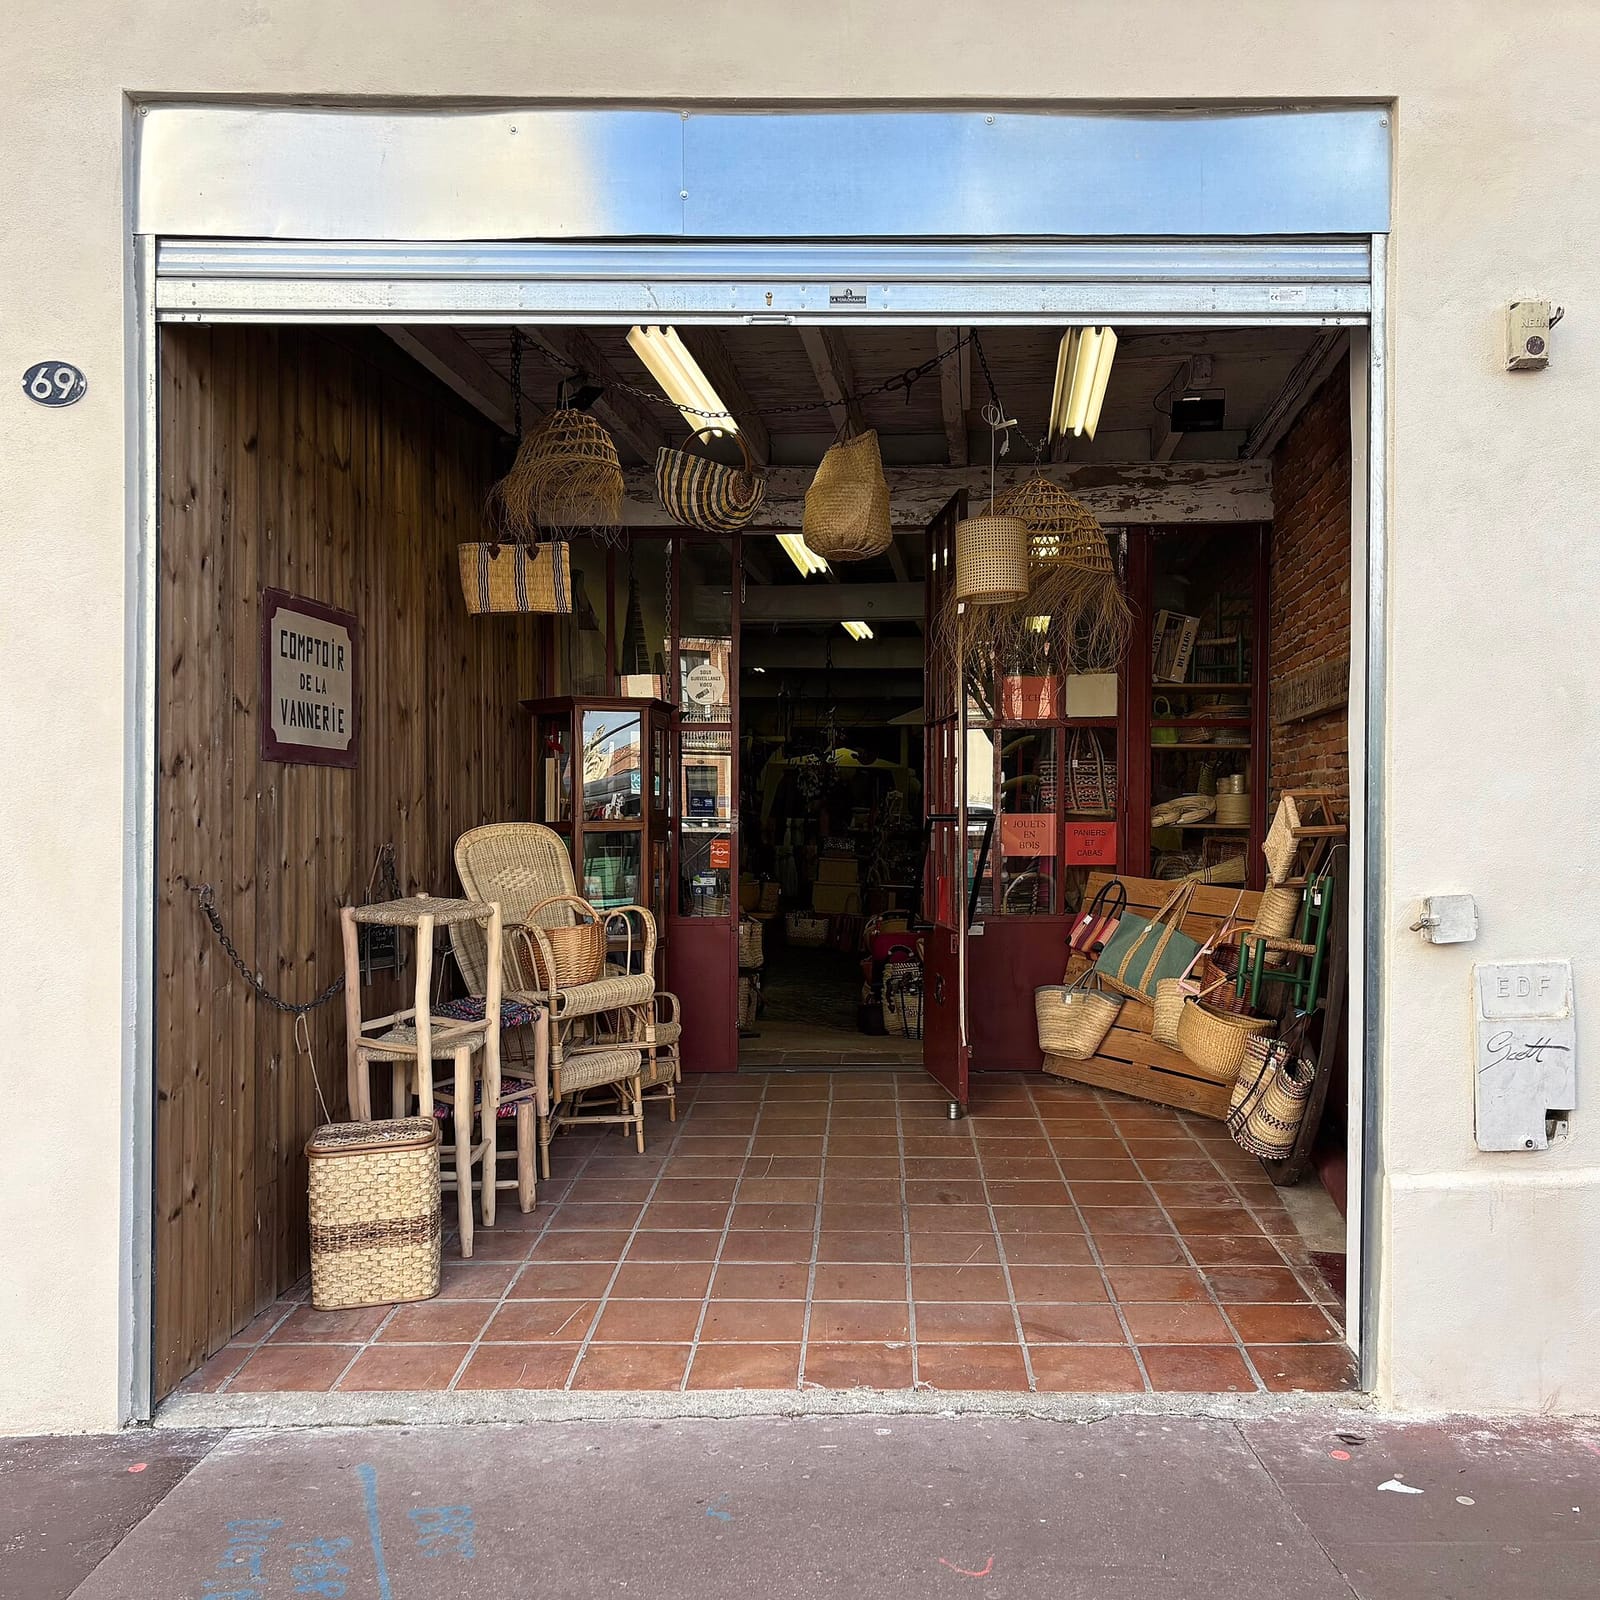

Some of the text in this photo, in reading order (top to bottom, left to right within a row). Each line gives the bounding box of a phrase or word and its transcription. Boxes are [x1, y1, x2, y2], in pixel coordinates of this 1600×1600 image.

[30, 367, 75, 399] 69
[1176, 631, 1192, 668] DU CLOS
[299, 673, 327, 695] DE LA
[1013, 820, 1046, 829] JOUETS
[1024, 830, 1036, 839] EN
[1073, 829, 1107, 837] PANIERS
[1019, 841, 1040, 850] BOIS
[1085, 839, 1094, 847] ET
[1077, 849, 1103, 857] CABAS
[1495, 976, 1552, 998] EDF
